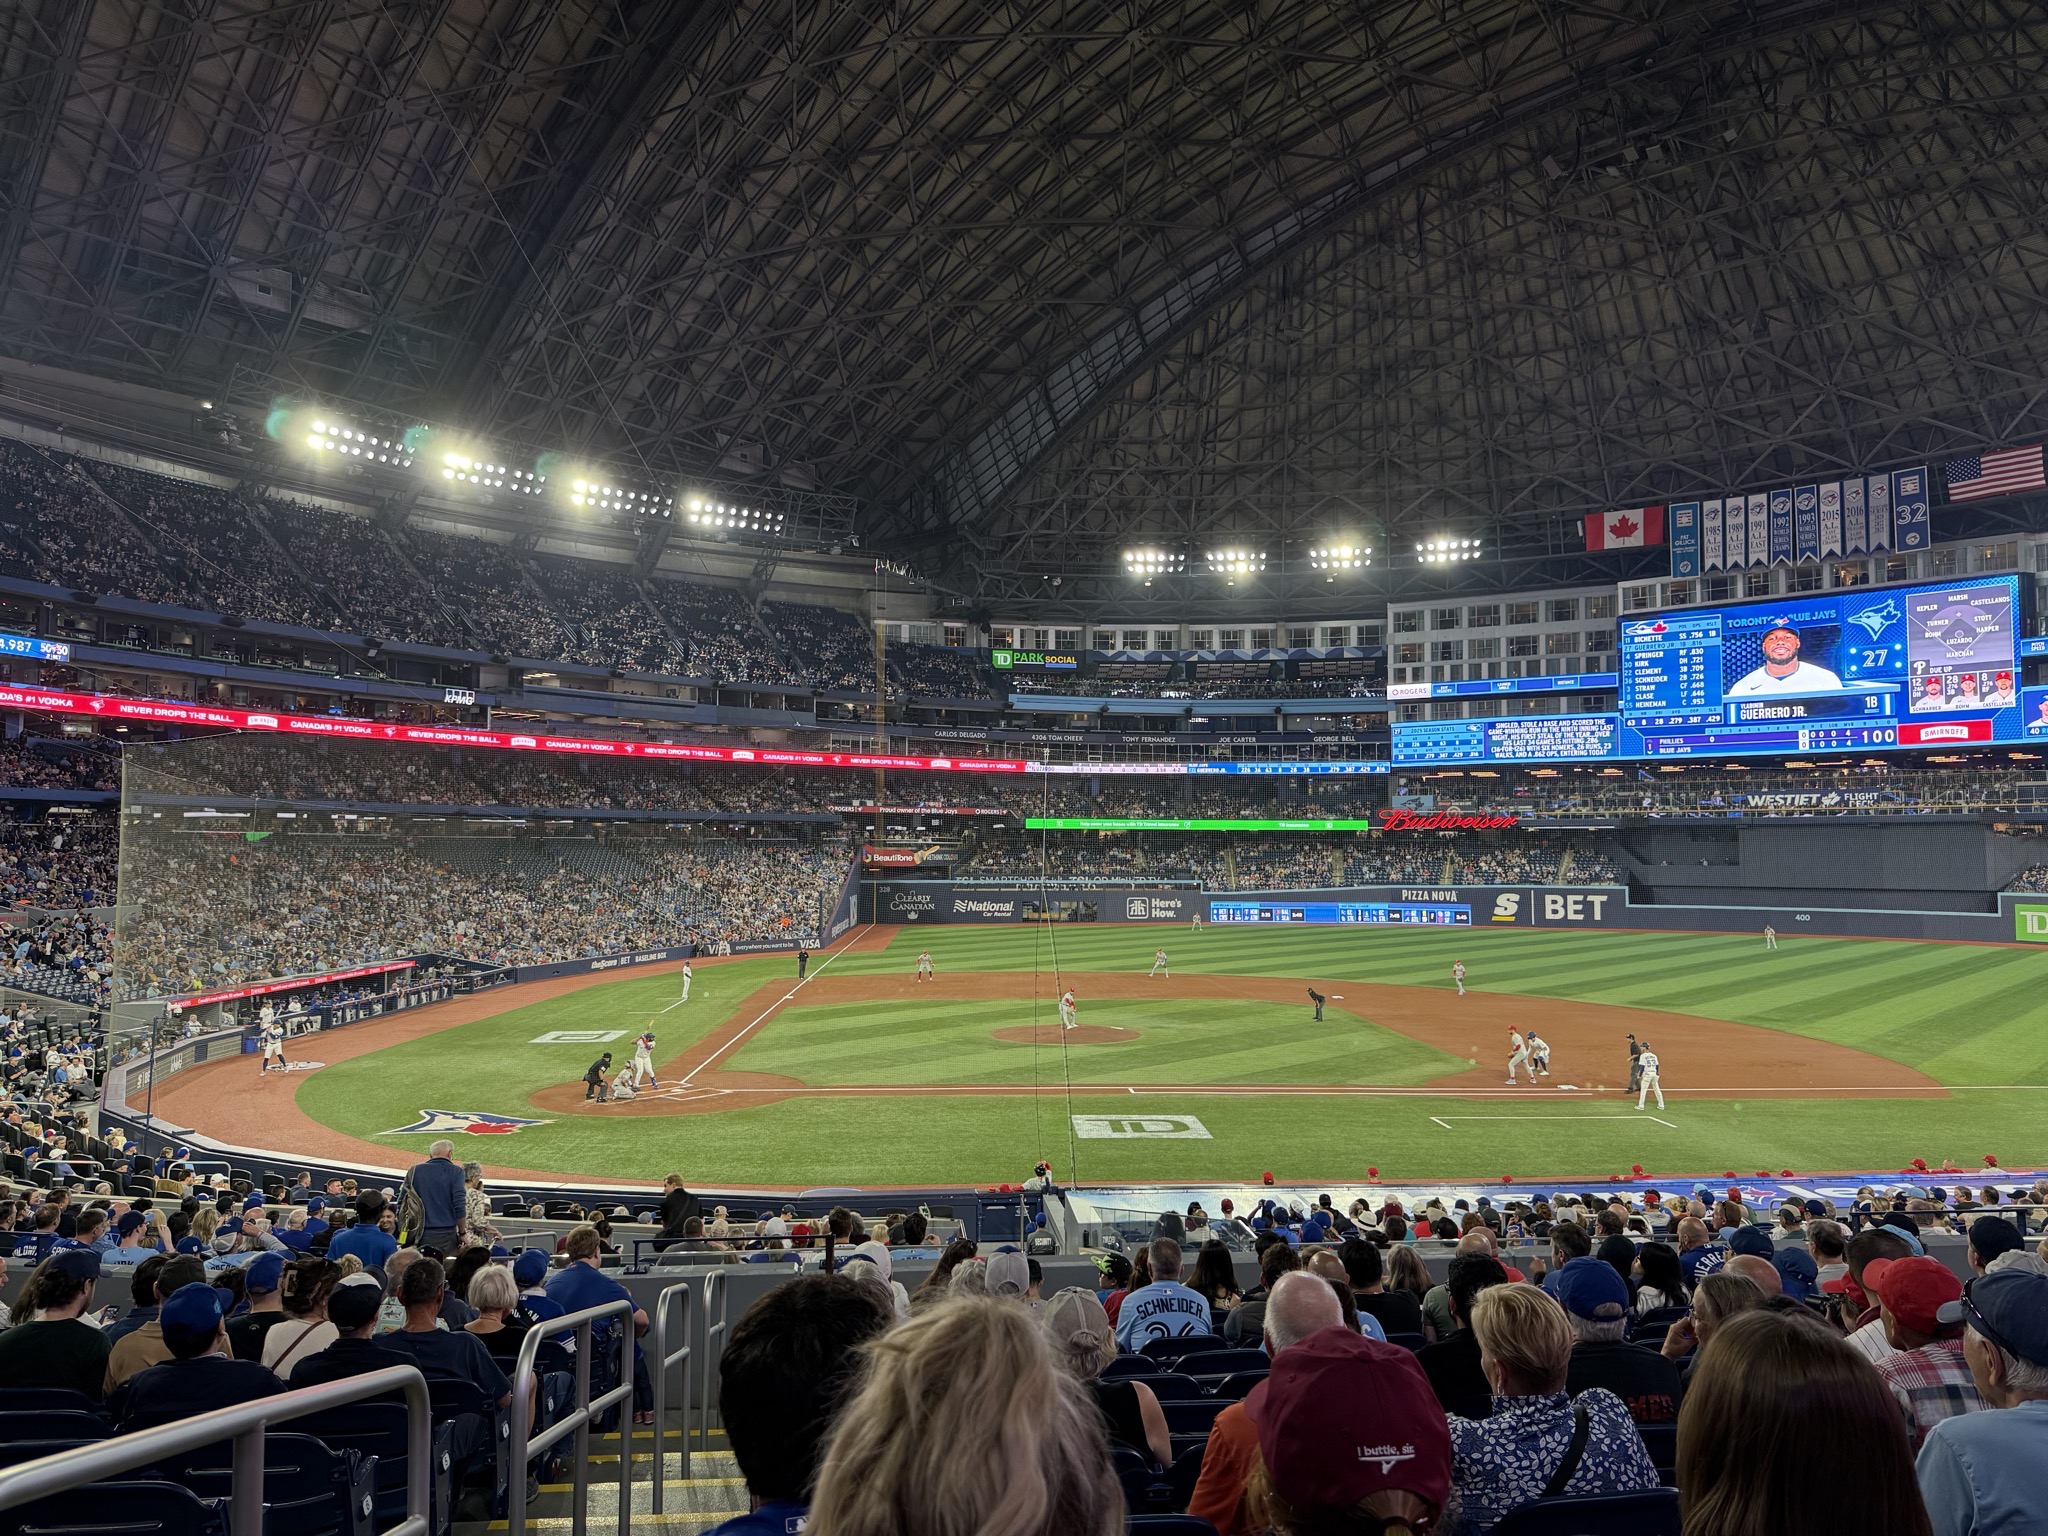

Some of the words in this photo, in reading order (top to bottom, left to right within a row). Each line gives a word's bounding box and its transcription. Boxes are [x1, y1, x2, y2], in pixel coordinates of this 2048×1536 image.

[1822, 510, 1839, 520] 2015
[1847, 506, 1863, 517] 2016
[1897, 503, 1926, 525] 32
[1774, 517, 1789, 528] 1992
[1799, 514, 1815, 524] 1993
[1728, 523, 1743, 533] 1989
[1751, 520, 1765, 531] 1991
[1705, 526, 1721, 536] 1985
[1728, 543, 1743, 551] EAST
[1751, 540, 1766, 549] EAST
[1971, 596, 2010, 606] CASTELLANOS
[1812, 610, 1836, 620] JAYS
[995, 653, 1010, 665] TD
[1014, 653, 1043, 662] PARK
[1634, 651, 1664, 659] SPRINGER
[1862, 650, 1888, 667] 27
[1912, 678, 1922, 686] 12
[1946, 676, 1958, 684] 28
[1400, 687, 1427, 695] ROGERS
[444, 694, 475, 705] KPMG
[1741, 707, 1789, 720] GUERRERO
[1792, 706, 1807, 717] JR.
[1864, 696, 1878, 708] 1B
[26, 696, 37, 704] #1
[38, 697, 73, 707] VODKA
[120, 705, 152, 715] NEVER
[155, 707, 187, 718] DROPS
[189, 711, 206, 719] THE
[208, 713, 234, 722] BALL.
[291, 721, 332, 731] CANADA'S
[344, 726, 371, 734] VODKA
[1873, 730, 1882, 742] 0
[1885, 730, 1894, 742] 0
[1746, 793, 1821, 807] WESTJET
[1844, 792, 1878, 800] FLIGHT
[1378, 808, 1517, 830] Budweiser
[873, 854, 913, 862] BeautiTone
[895, 893, 930, 903] CLEARLY
[1402, 890, 1429, 901] PIZZA
[1431, 892, 1457, 902] NOVA
[890, 901, 935, 911] CANADIAN
[1152, 898, 1182, 908] Here's
[1545, 894, 1607, 920] BET
[1152, 909, 1176, 918] How.
[798, 939, 821, 949] VISA
[591, 959, 618, 970] theScore
[621, 956, 630, 966] BET
[635, 952, 655, 962] BASELINE
[656, 952, 667, 960] BOX
[1136, 1298, 1203, 1320] SCHNEIDER
[1357, 1446, 1361, 1456] I
[1363, 1444, 1399, 1456] buttle,
[1402, 1443, 1415, 1454] sir.
